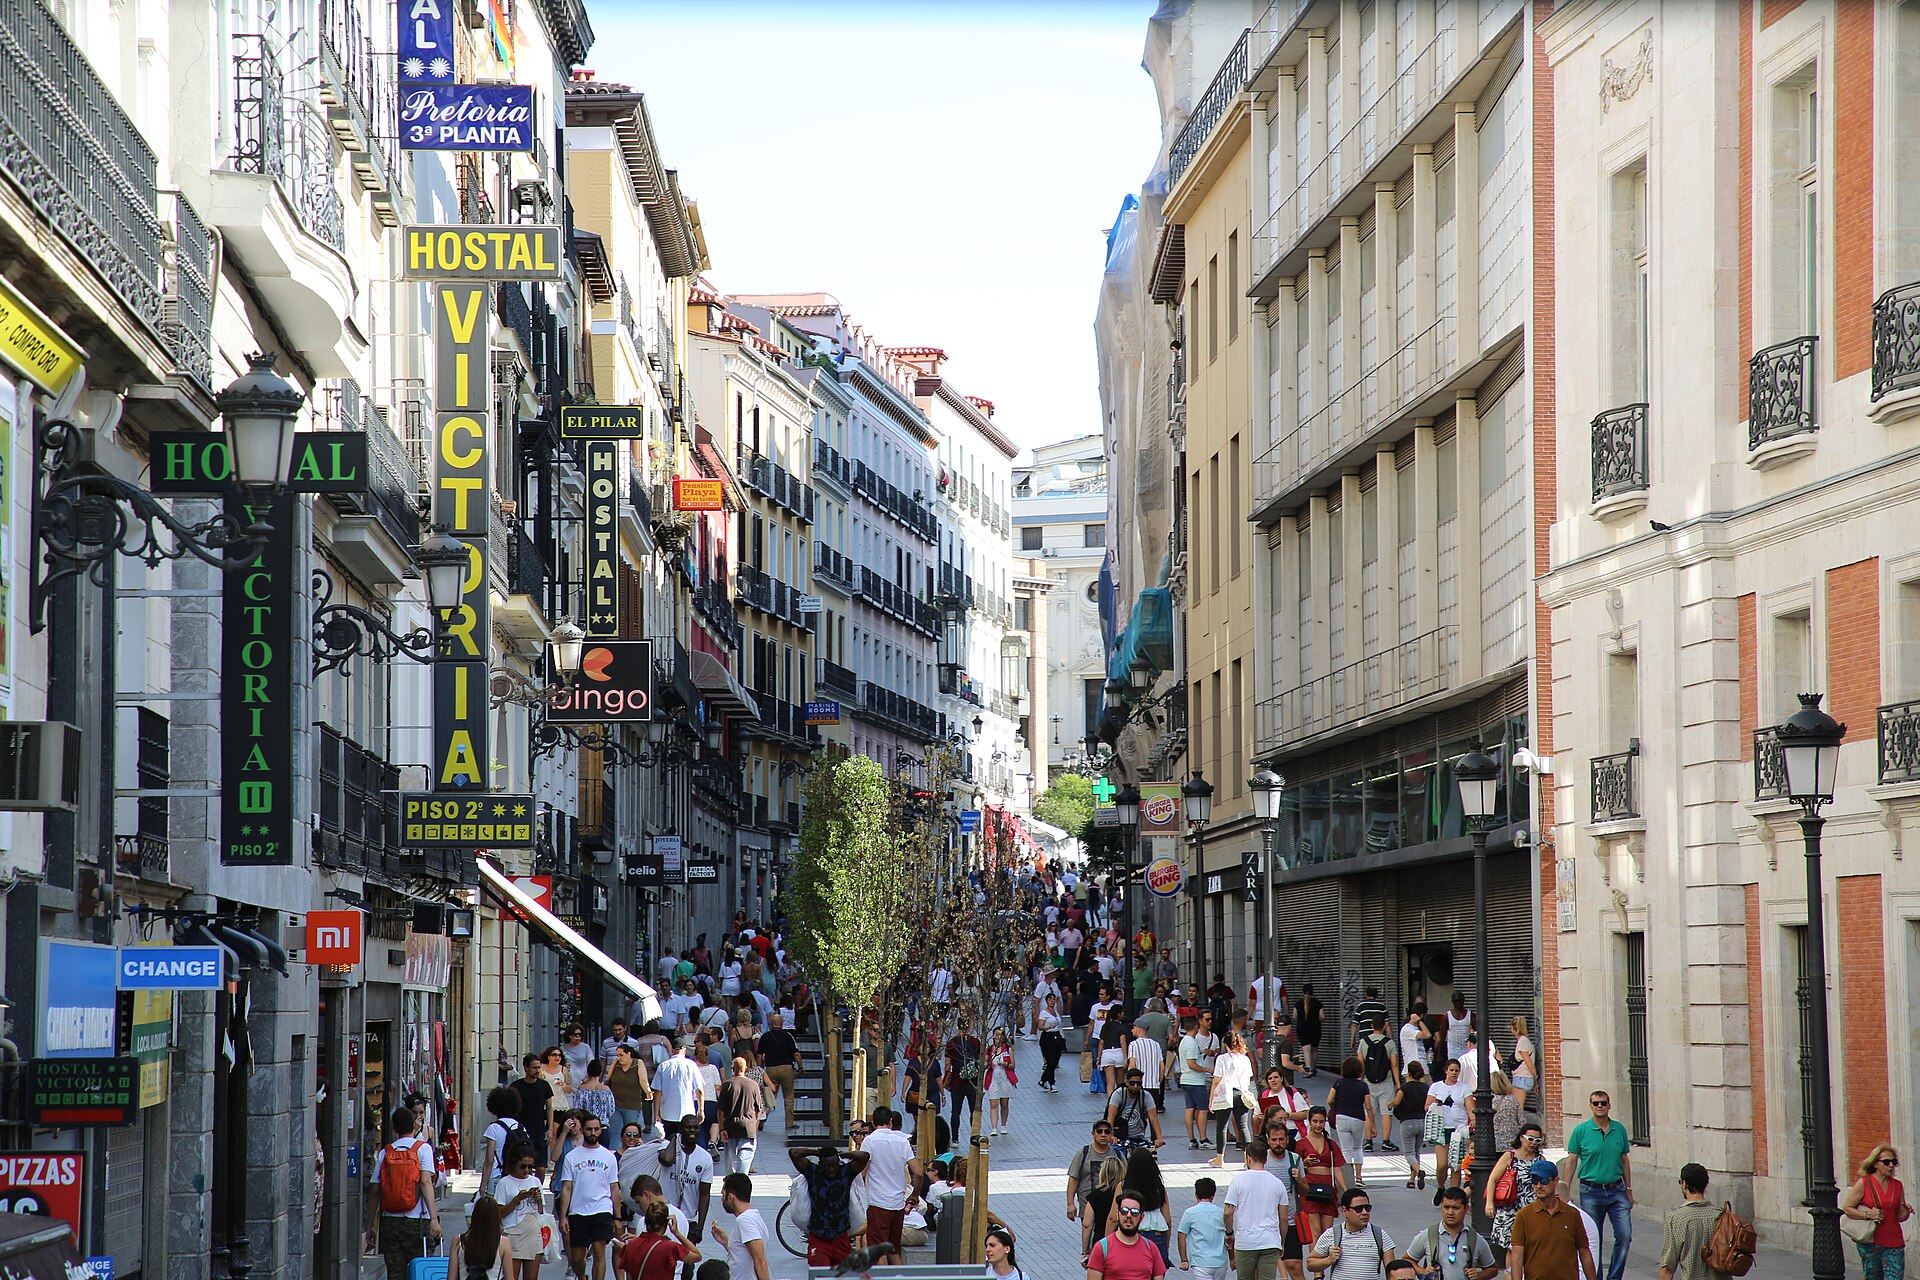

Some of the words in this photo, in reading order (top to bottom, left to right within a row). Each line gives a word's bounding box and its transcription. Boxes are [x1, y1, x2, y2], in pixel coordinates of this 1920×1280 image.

[401, 91, 529, 123] Pretoria
[440, 127, 521, 144] PLANTA
[410, 232, 555, 270] HOSTAL
[8, 324, 45, 361] COMPRO
[36, 349, 60, 374] ORO
[567, 416, 587, 428] EL
[590, 416, 638, 428] PILAR
[163, 443, 356, 481] HOAL
[683, 489, 716, 497] Playa
[592, 451, 613, 606] HOSTAL
[407, 801, 459, 819] PISO
[1147, 798, 1171, 811] BURGER
[1148, 804, 1172, 818] KING
[230, 844, 262, 856] PISO
[628, 865, 657, 876] celio
[1149, 864, 1179, 881] BURGER
[1246, 853, 1257, 901] ZARA
[1151, 871, 1181, 890] KING
[123, 961, 216, 977] CHANGE
[37, 1063, 101, 1075] HOSTAL
[37, 1077, 114, 1089] VICTORIA
[0, 1157, 76, 1186] PIZZAS
[574, 1159, 609, 1171] TOMMY
